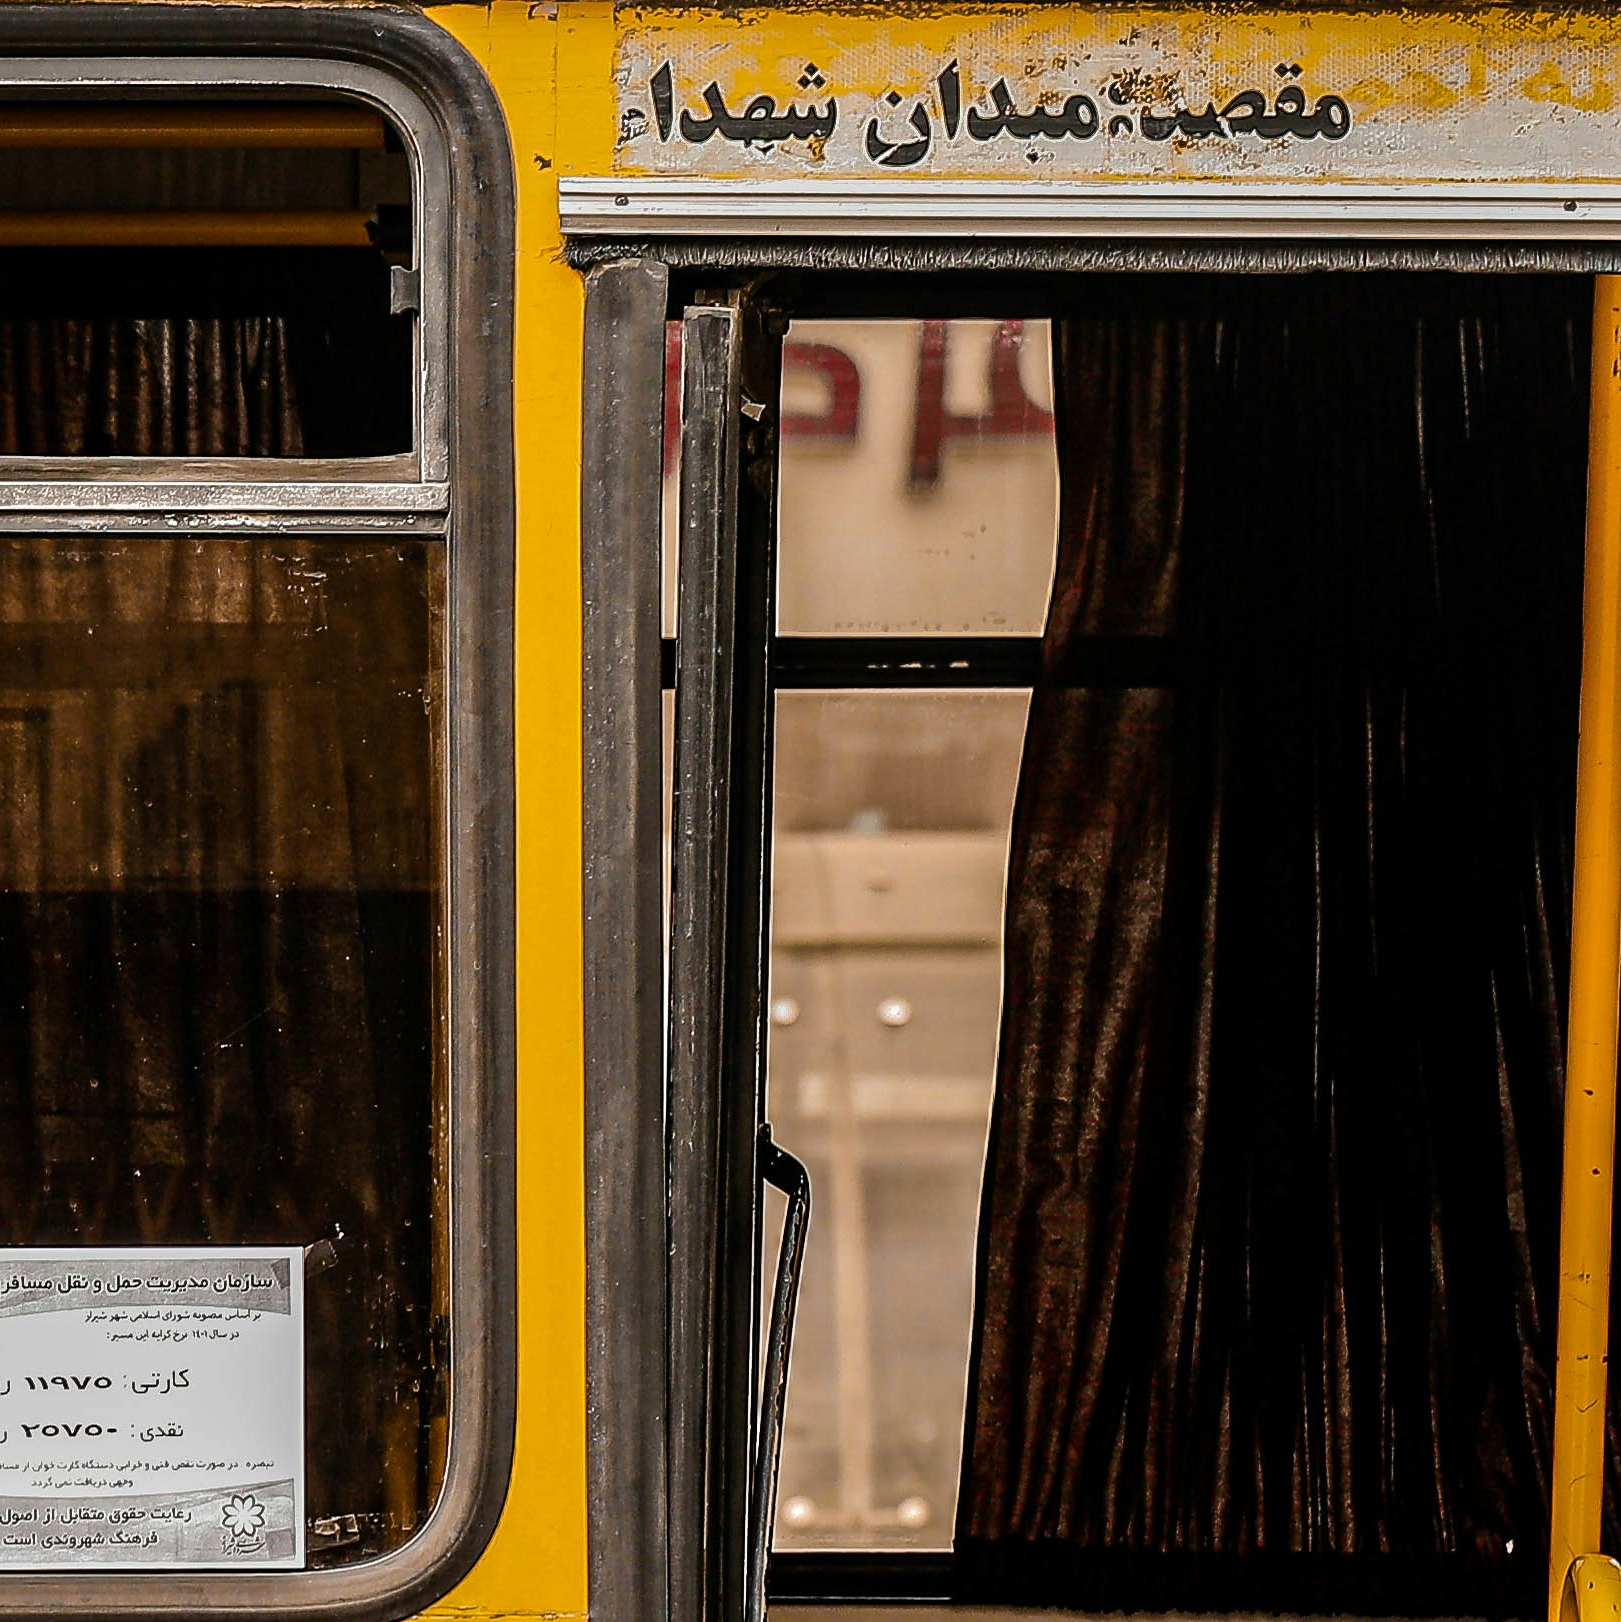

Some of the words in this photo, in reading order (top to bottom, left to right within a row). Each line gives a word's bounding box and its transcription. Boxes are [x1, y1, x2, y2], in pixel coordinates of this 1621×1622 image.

[2, 1275, 52, 1296] مسافر
[58, 1275, 88, 1294] نقل
[107, 1275, 142, 1293] حمل
[147, 1276, 208, 1293] مدیریت
[213, 1274, 272, 1293] سازمان
[0, 1508, 38, 1525] اصول
[61, 1508, 105, 1524] متقابل
[109, 1507, 146, 1524] حقوق
[150, 1507, 192, 1523] رعایت
[3, 1533, 36, 1545] است
[41, 1532, 105, 1549] شهروندی
[109, 1530, 158, 1548] فرهنگ
